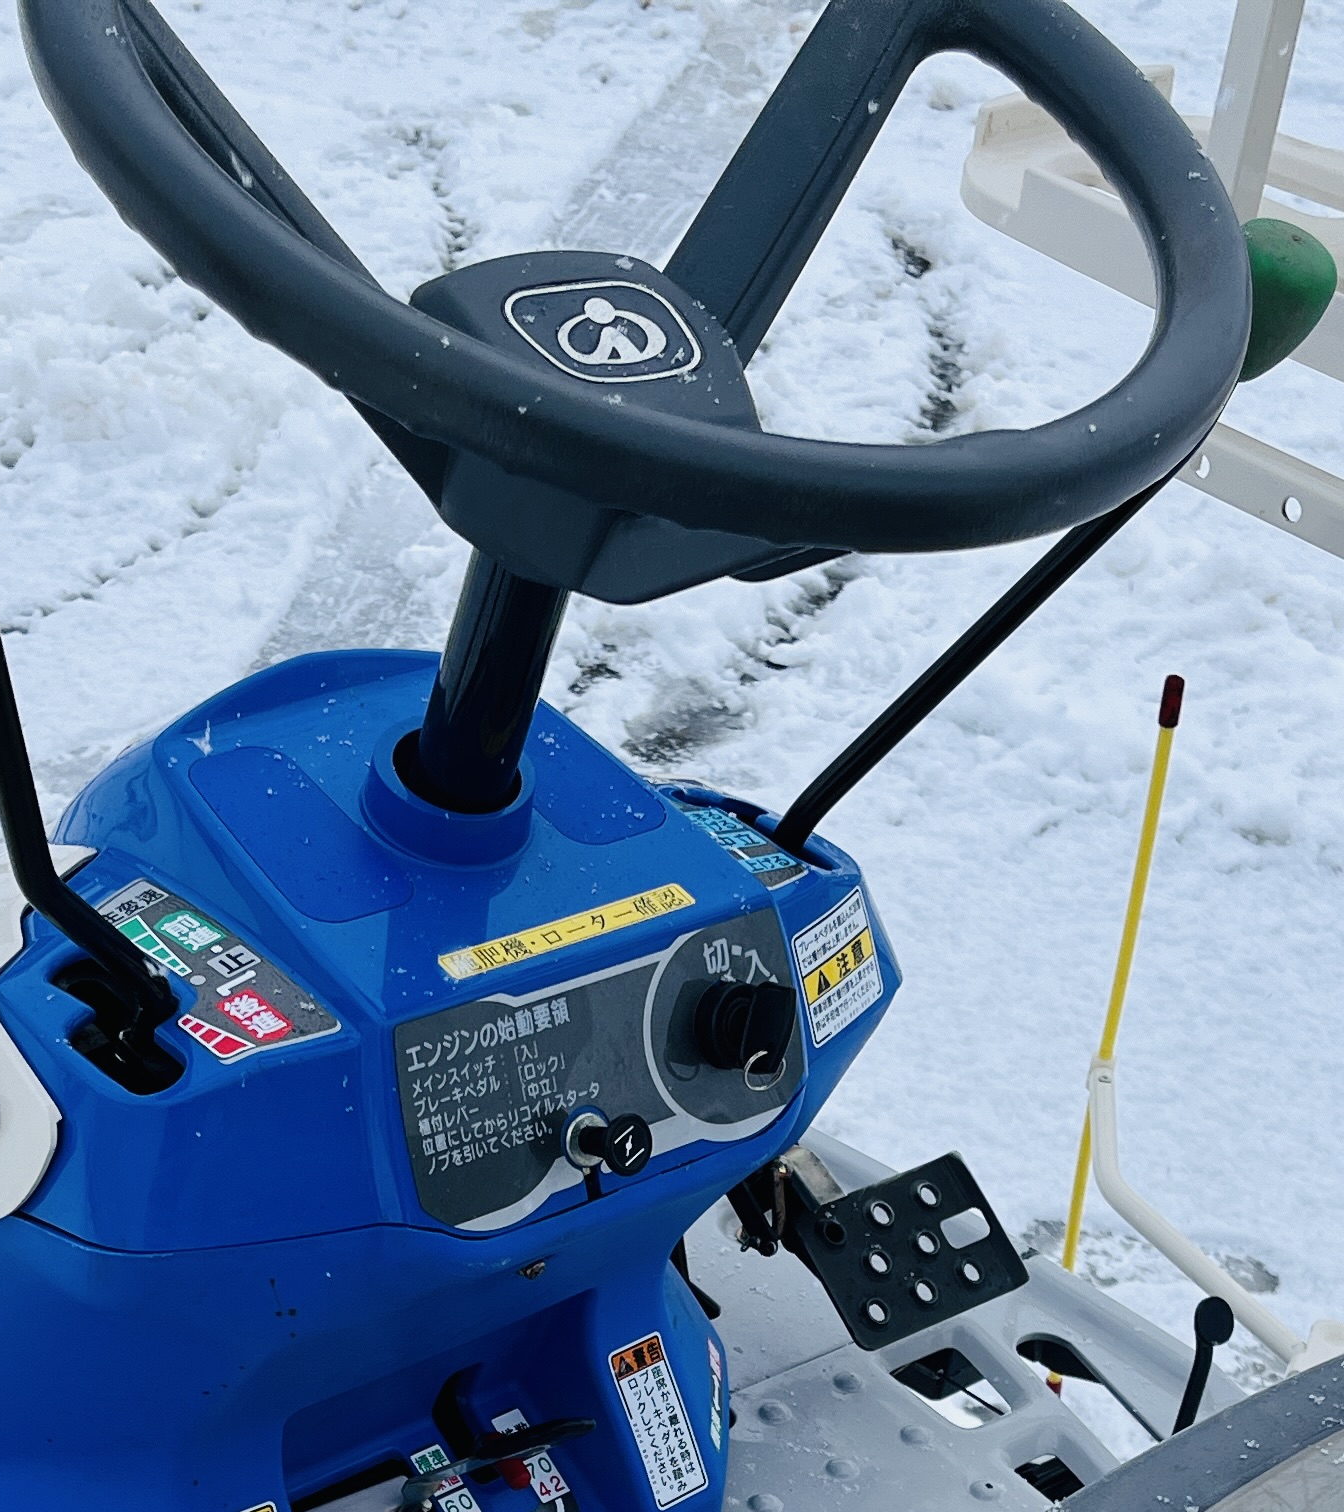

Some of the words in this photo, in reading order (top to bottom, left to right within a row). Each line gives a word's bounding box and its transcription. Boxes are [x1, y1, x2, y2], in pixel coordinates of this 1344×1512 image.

[745, 856, 789, 871] 上げる
[160, 914, 222, 951] 前進
[218, 951, 256, 975] 止
[703, 938, 730, 974] 切
[836, 938, 865, 979] 注意
[223, 994, 288, 1039] 後進
[406, 997, 571, 1072] エンジンの始動要領
[412, 1054, 497, 1099] メインスイッチ
[414, 1075, 501, 1118] ブレーキペダル
[517, 1052, 566, 1084] 「ロック」
[418, 1105, 480, 1137] 植付レバー
[521, 1076, 558, 1102] 「中立」
[422, 1080, 600, 1157] 位置にしてからリコイルスタータ
[428, 1121, 554, 1176] ノブを引いてください。
[627, 1377, 675, 1491] ロックしてください。
[639, 1370, 688, 1492] ブレーキペダルを踏み
[525, 1457, 553, 1480] 70
[539, 1475, 566, 1498] 42
